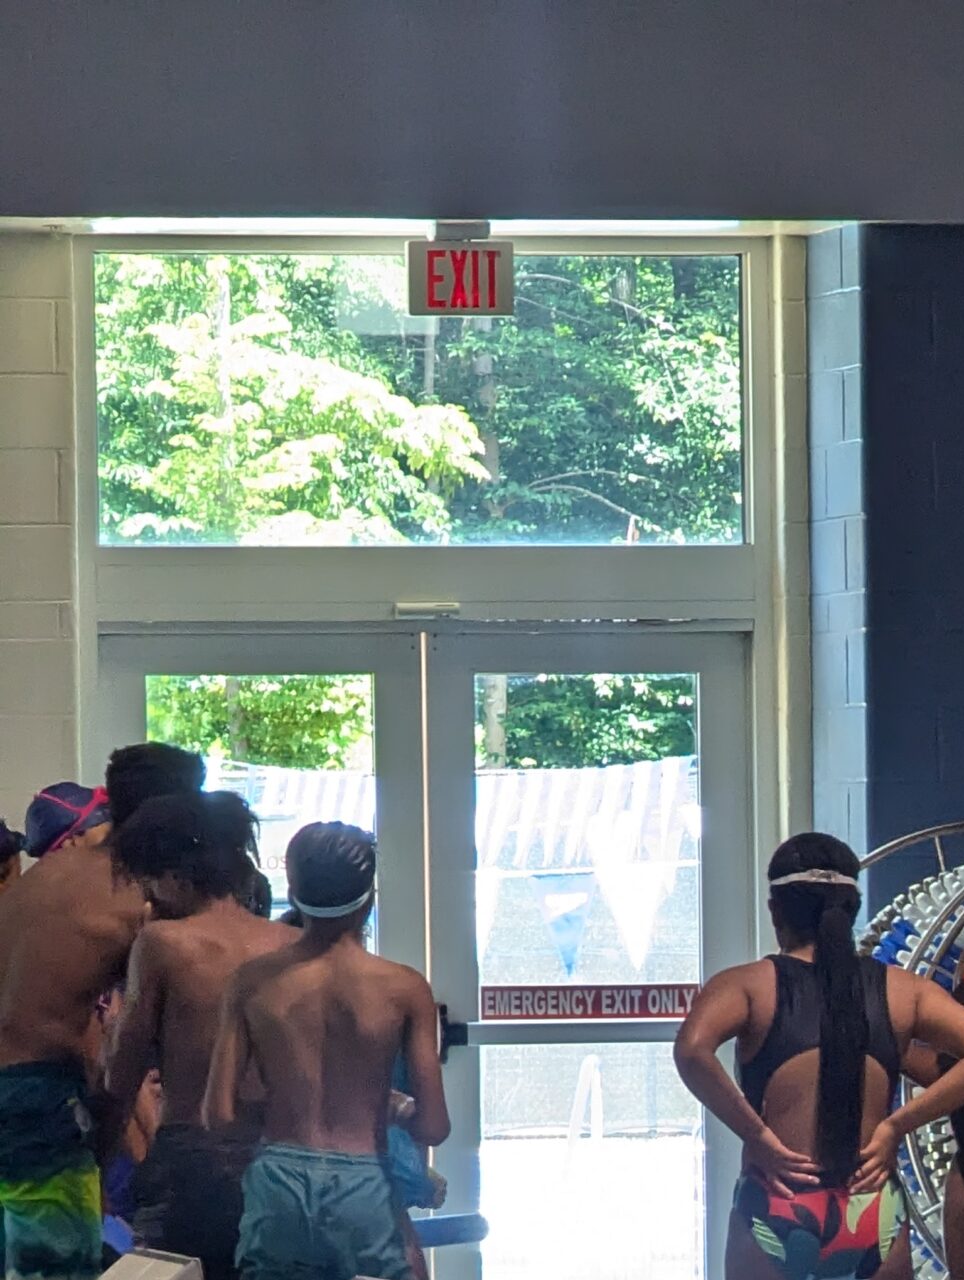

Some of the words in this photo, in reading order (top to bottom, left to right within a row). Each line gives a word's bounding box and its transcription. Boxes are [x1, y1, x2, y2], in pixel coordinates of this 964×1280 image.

[427, 249, 501, 308] EXIT
[483, 989, 596, 1016] EMERGENCY
[601, 989, 643, 1015] EXIT
[647, 988, 695, 1014] ONLY
